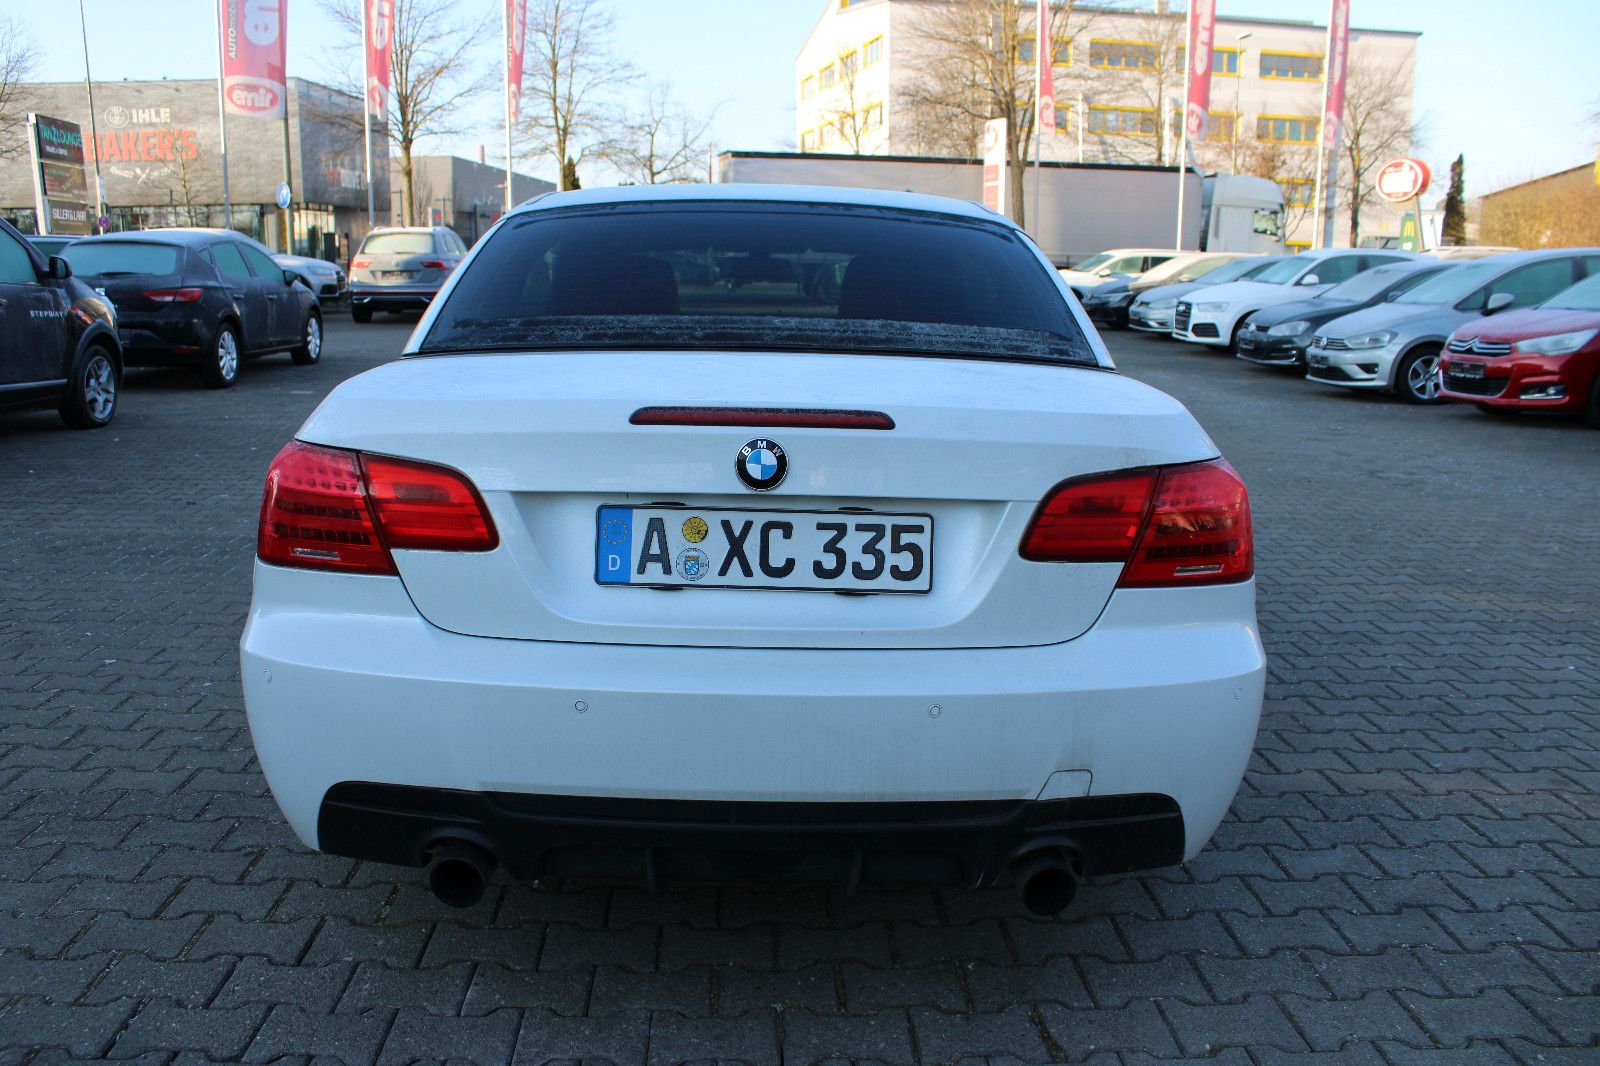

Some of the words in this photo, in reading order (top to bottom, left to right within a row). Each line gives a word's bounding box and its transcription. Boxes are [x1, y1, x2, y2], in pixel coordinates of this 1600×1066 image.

[231, 87, 273, 107] emir
[131, 107, 171, 123] IHLE
[30, 310, 64, 318] STEPWAY
[636, 517, 672, 576] A
[717, 519, 796, 579] XC
[812, 521, 925, 582] 335
[608, 554, 621, 571] D
